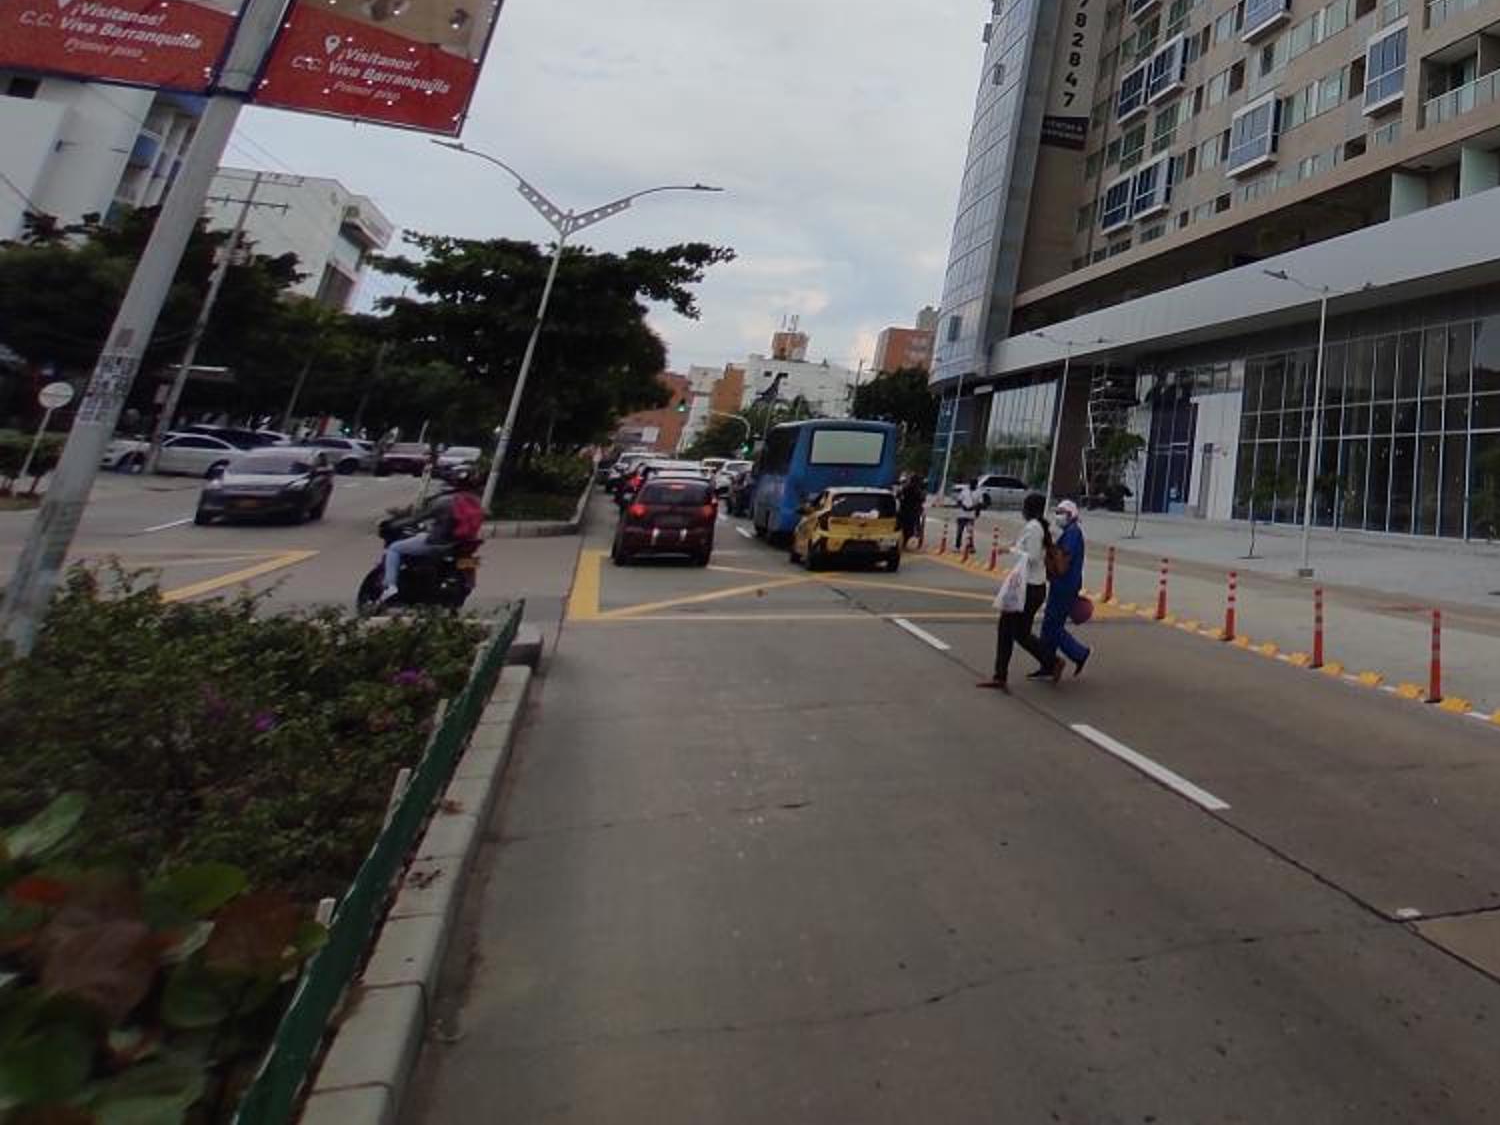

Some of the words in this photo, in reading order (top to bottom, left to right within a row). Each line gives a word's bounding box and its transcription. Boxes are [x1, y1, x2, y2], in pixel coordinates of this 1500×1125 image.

[60, 17, 96, 33] Viva
[99, 23, 203, 49] Barranquilla
[328, 61, 361, 78] Viva
[362, 67, 451, 94] Barranquilla
